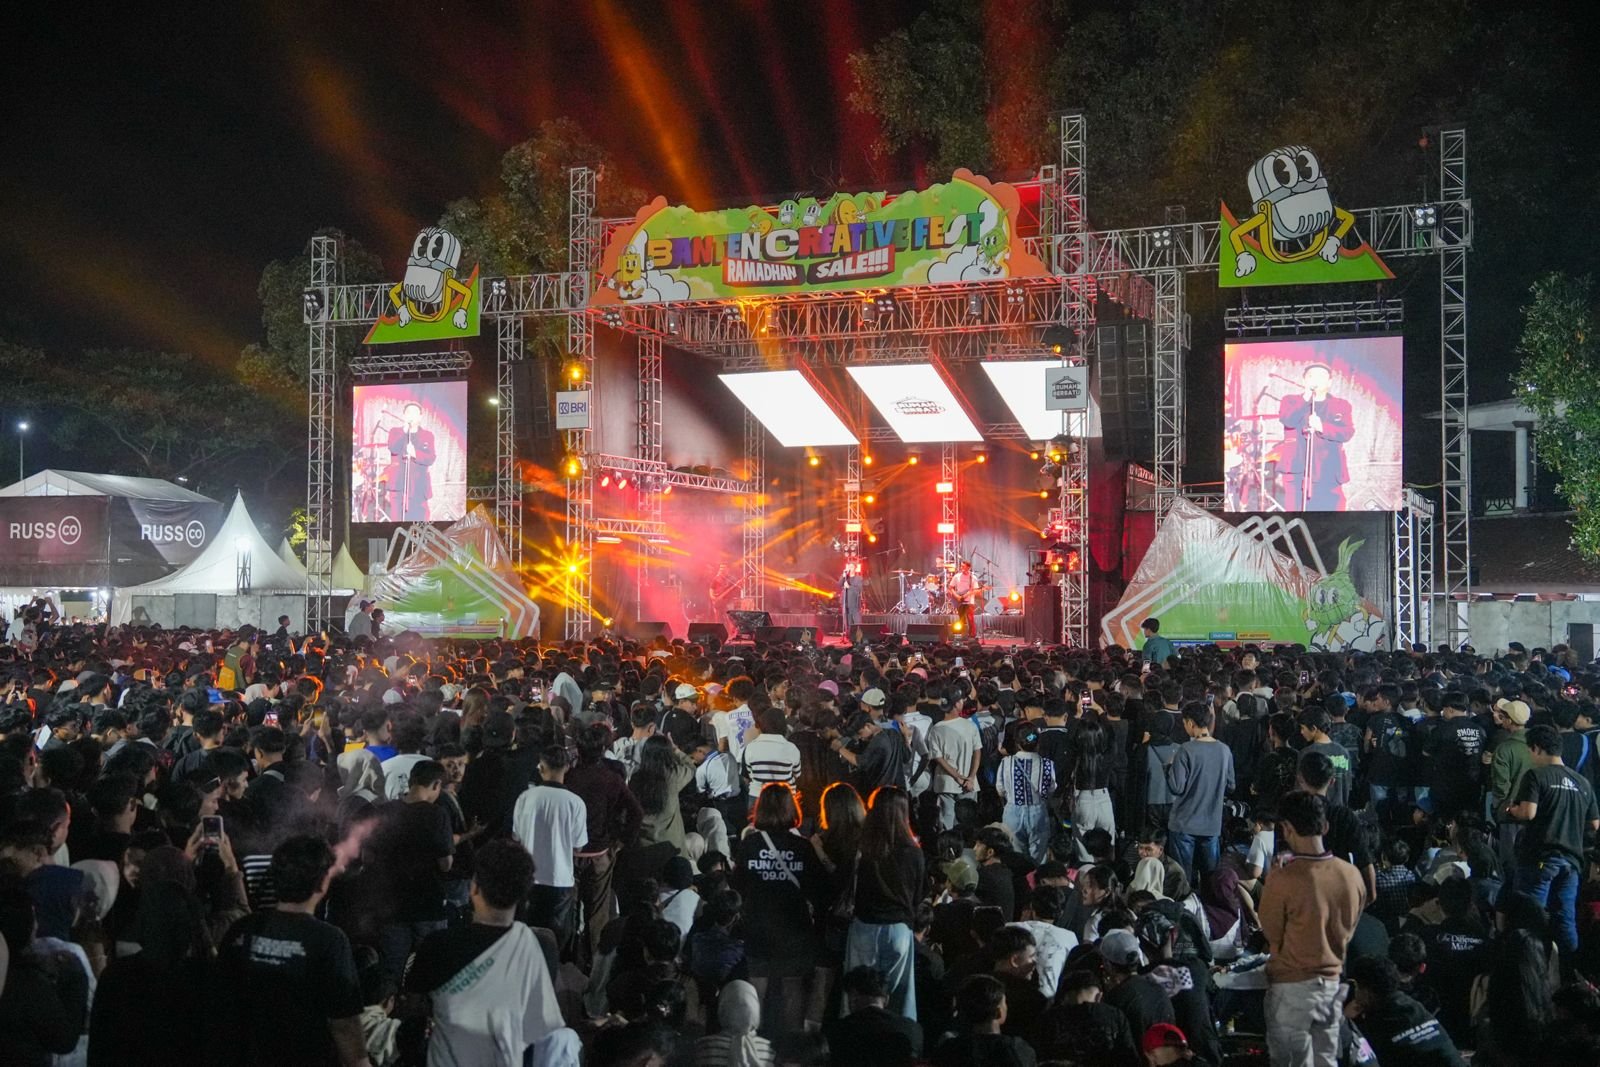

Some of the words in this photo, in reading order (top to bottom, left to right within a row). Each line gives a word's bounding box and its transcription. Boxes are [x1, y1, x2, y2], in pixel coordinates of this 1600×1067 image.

[647, 232, 761, 268] BANTEN
[764, 218, 910, 258] CREATIVE
[912, 211, 986, 249] FEST
[727, 260, 798, 283] RAMADHAN
[816, 247, 890, 279] SALE!!!
[570, 401, 587, 413] BRI
[9, 522, 57, 540] RUSS
[140, 523, 185, 542] RUSS
[1456, 727, 1481, 738] SMOKE
